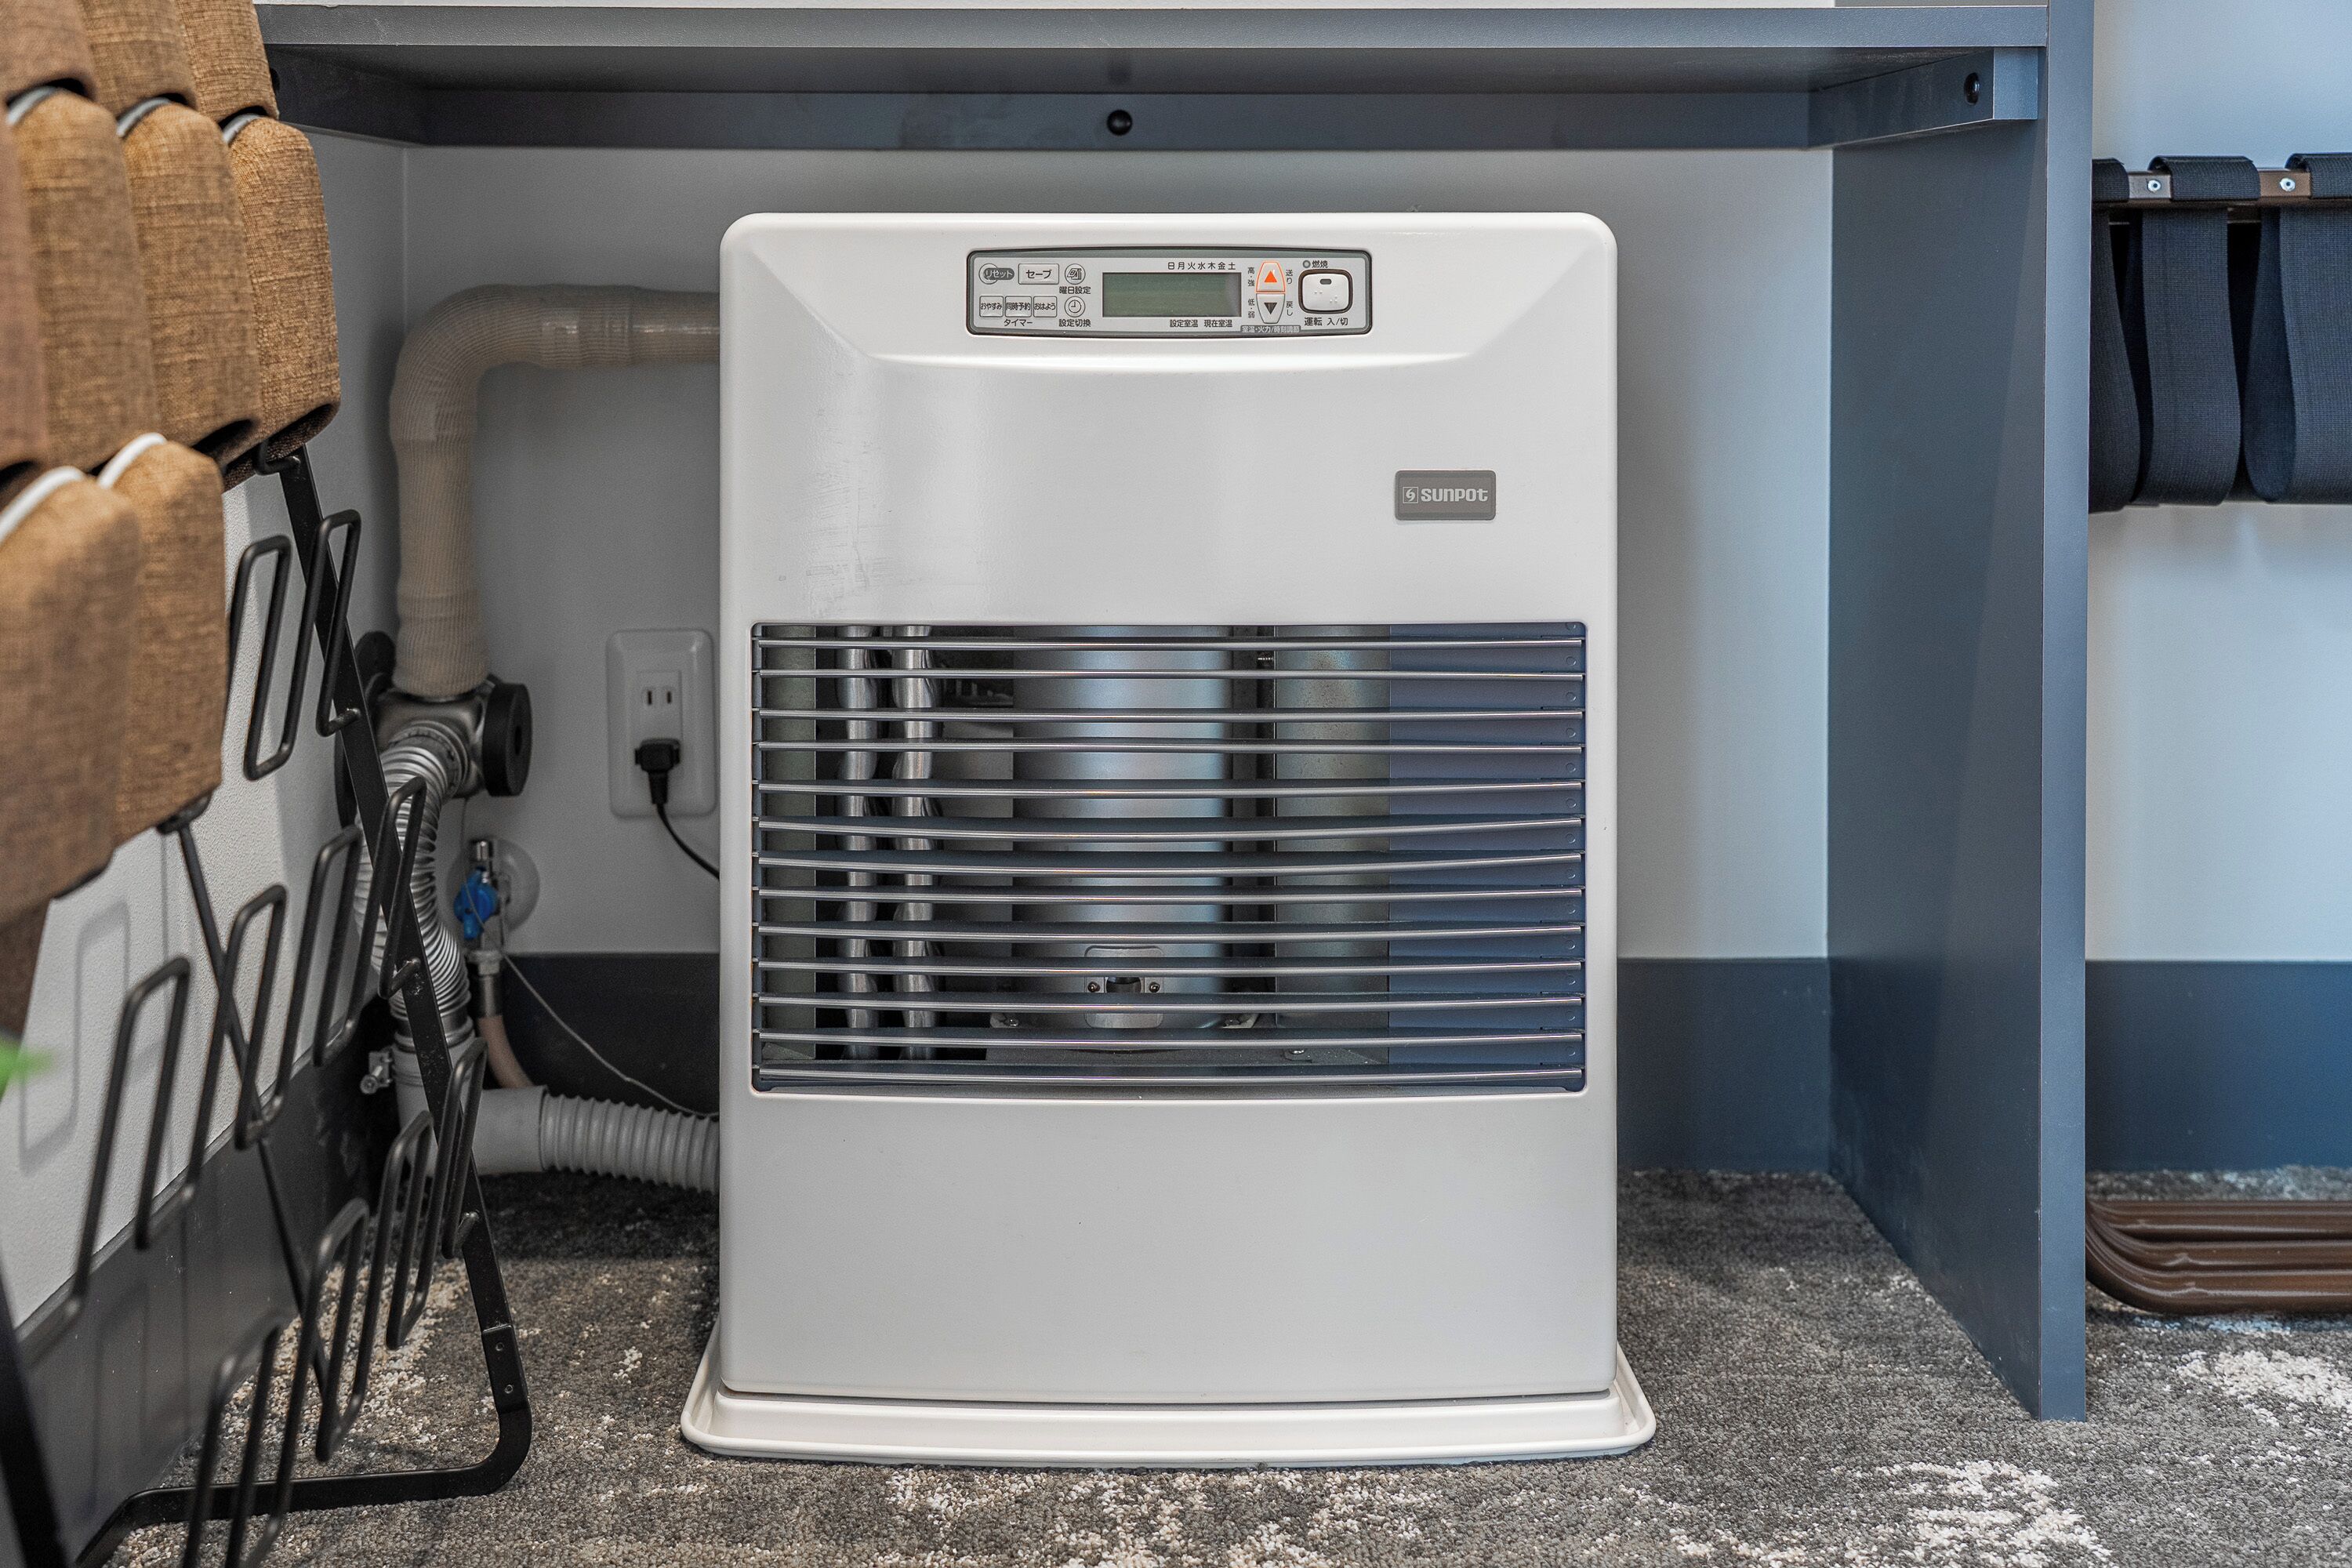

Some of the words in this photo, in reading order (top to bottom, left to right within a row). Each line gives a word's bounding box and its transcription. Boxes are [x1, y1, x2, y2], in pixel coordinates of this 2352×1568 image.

[985, 270, 1014, 279] リセット
[1025, 269, 1052, 279] セーブ
[1286, 269, 1293, 284] 送り
[1059, 286, 1091, 295] 曜日設定
[980, 302, 1003, 310] おやすみ
[1034, 302, 1056, 310] おはよう
[1286, 301, 1293, 316] 戻し
[1004, 318, 1033, 327] タイマー
[1304, 318, 1322, 326] 運転
